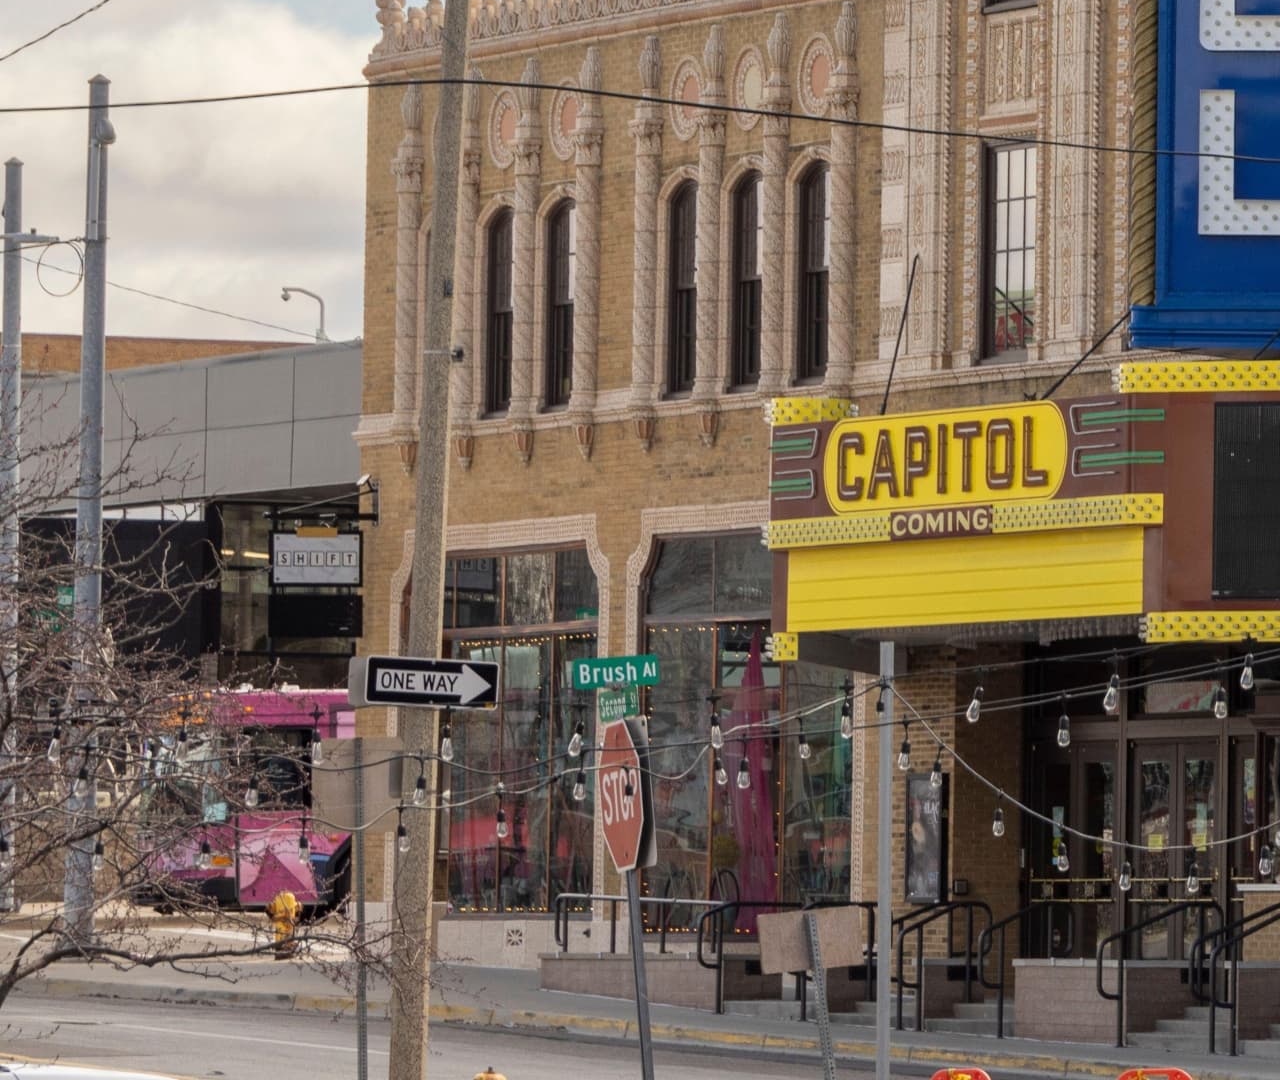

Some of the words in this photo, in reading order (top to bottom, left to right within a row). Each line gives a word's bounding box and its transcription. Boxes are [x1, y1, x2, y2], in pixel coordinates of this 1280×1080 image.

[837, 416, 1048, 501] CAPITOL
[892, 508, 989, 537] COMING
[280, 553, 353, 565] SHIFT
[381, 671, 415, 689] ONE
[423, 673, 458, 692] WAY
[579, 661, 637, 684] Brush
[600, 694, 627, 718] Second
[602, 768, 637, 825] STOP
